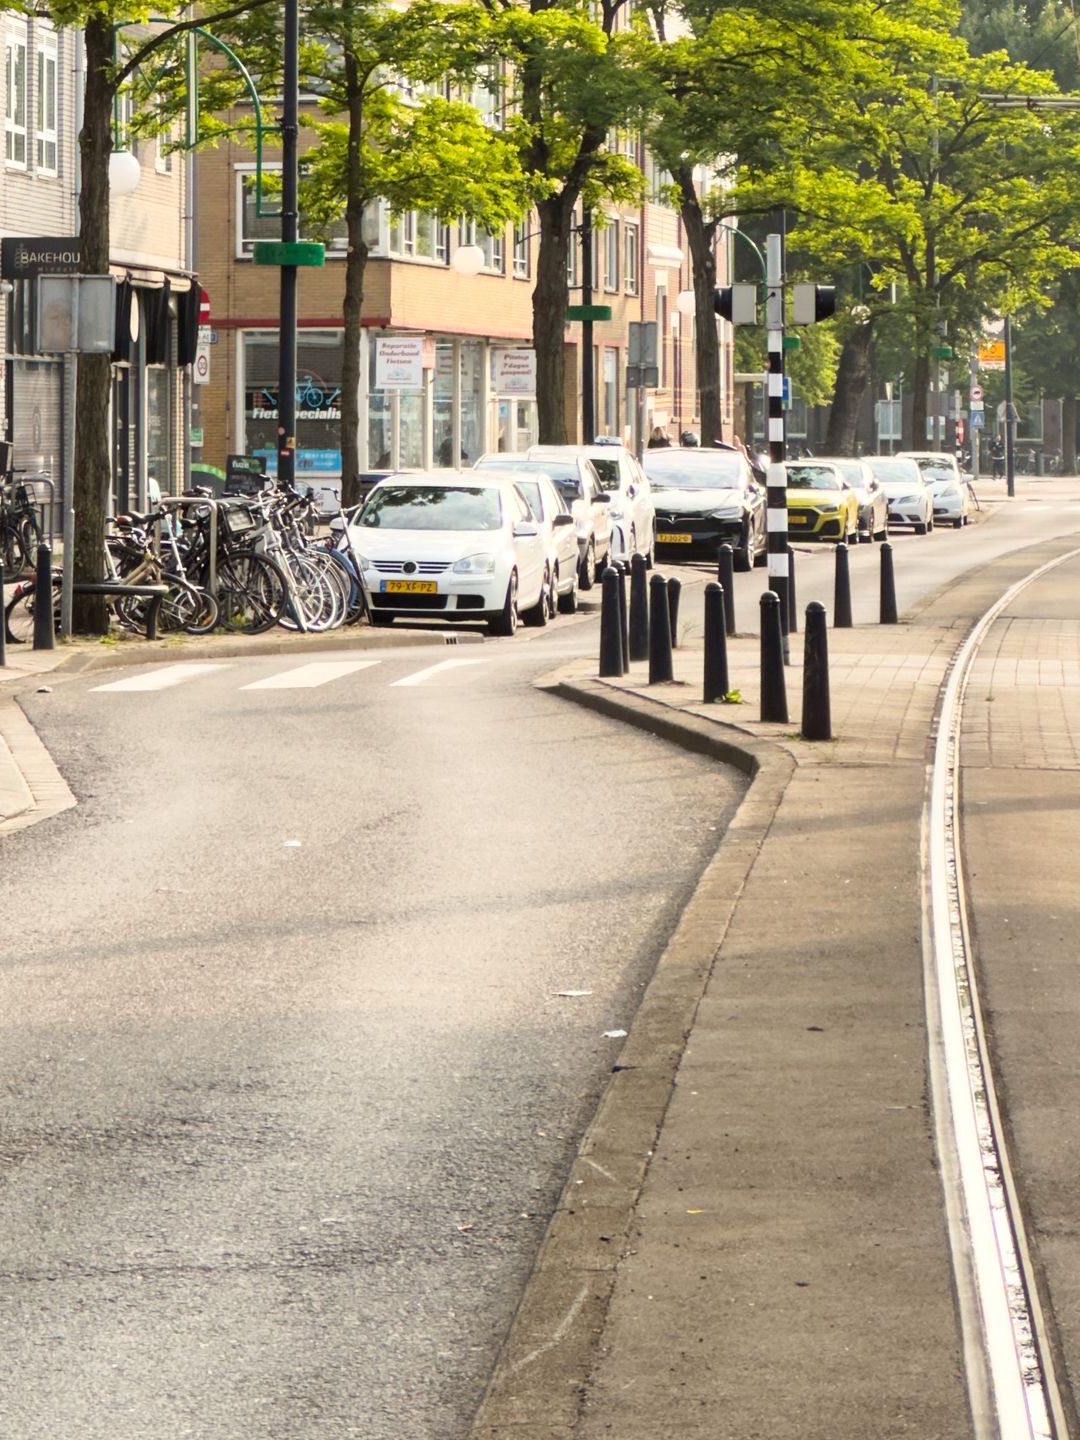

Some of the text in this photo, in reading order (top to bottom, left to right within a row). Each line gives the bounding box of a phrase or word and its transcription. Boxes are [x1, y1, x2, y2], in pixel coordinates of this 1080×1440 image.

[20, 251, 81, 264] BAKEHOU
[252, 407, 342, 420] Fietpecialis
[232, 460, 250, 469] fuze
